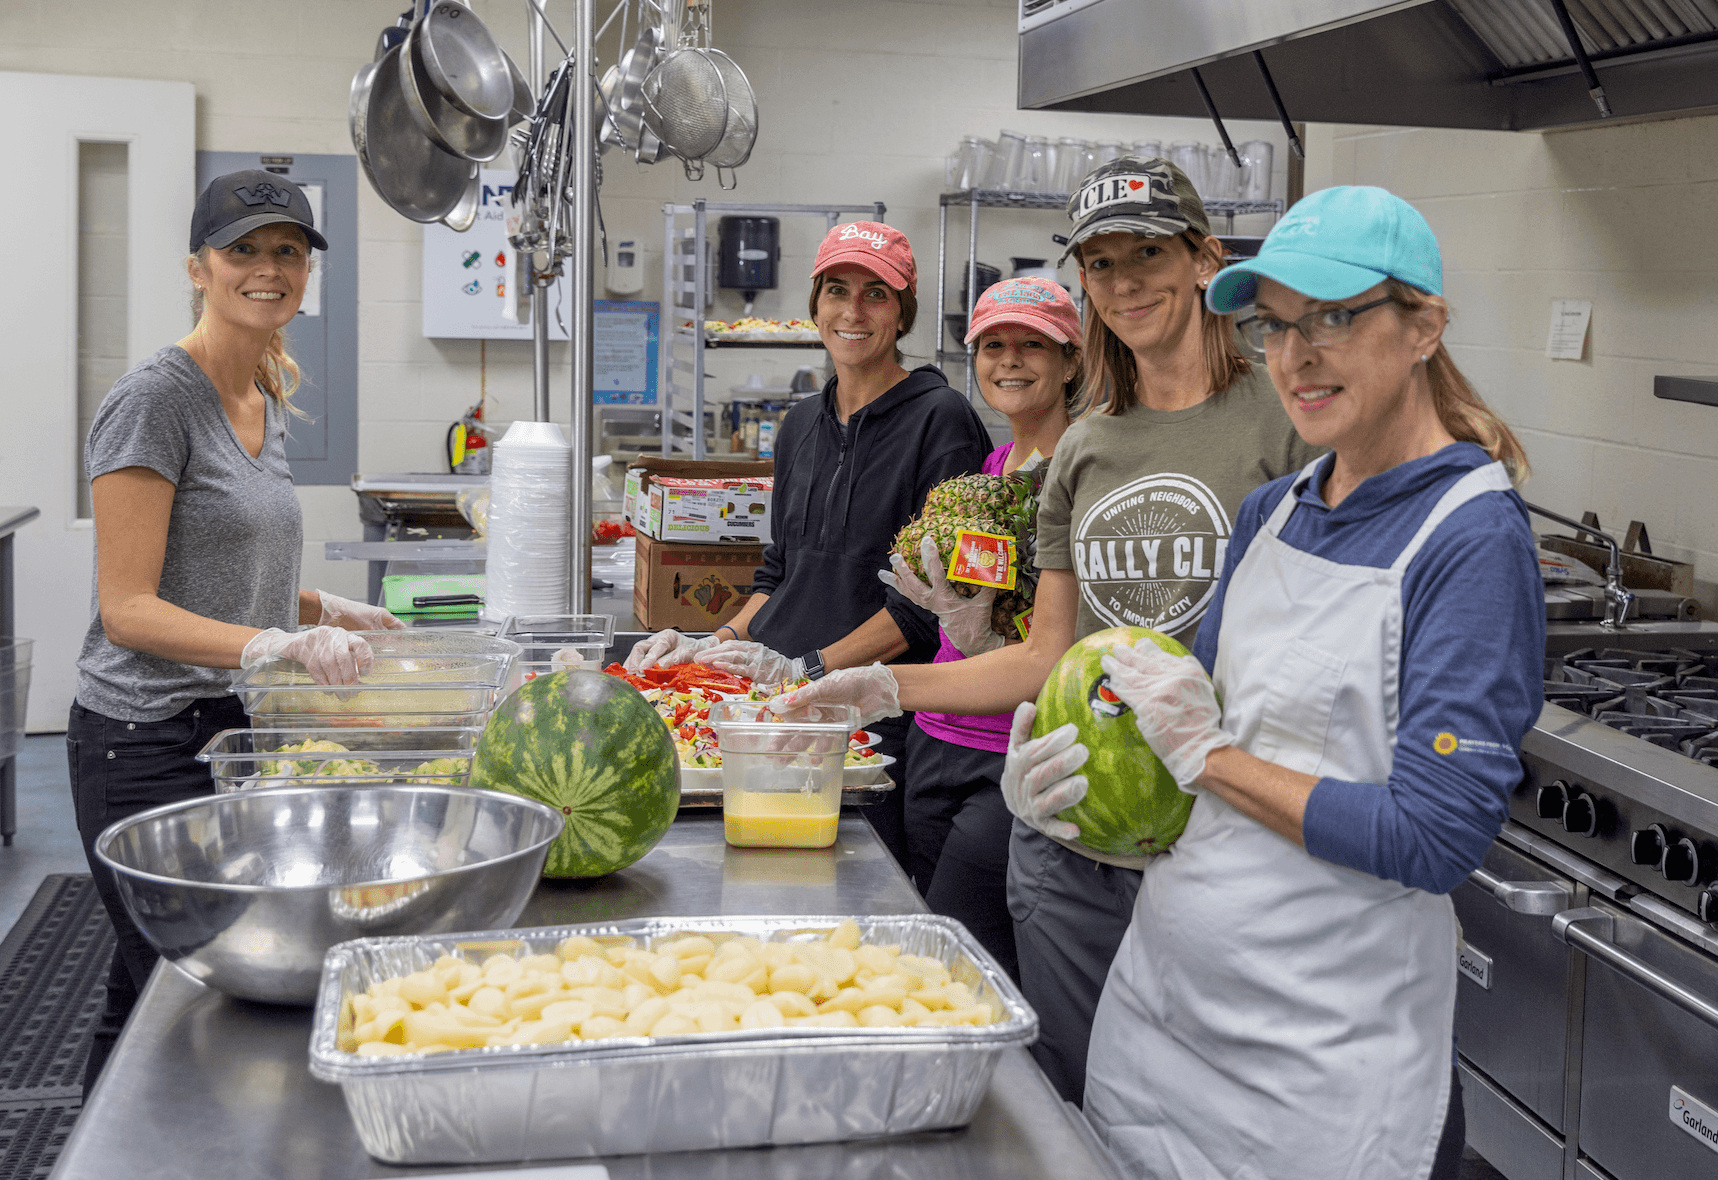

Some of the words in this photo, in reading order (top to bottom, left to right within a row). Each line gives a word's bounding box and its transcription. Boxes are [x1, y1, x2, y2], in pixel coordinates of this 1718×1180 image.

[1084, 180, 1127, 210] CLE
[839, 224, 888, 250] Bay
[1102, 494, 1145, 521] UNITING
[1149, 491, 1200, 515] NEIGHBORS
[685, 554, 764, 563] PEPPE
[1074, 539, 1162, 580] RALLY
[1108, 596, 1121, 611] TO
[1122, 608, 1155, 629] IMPACT
[1169, 596, 1193, 617] CITY
[1460, 955, 1484, 980] Garland
[1683, 1110, 1718, 1145] Garland
